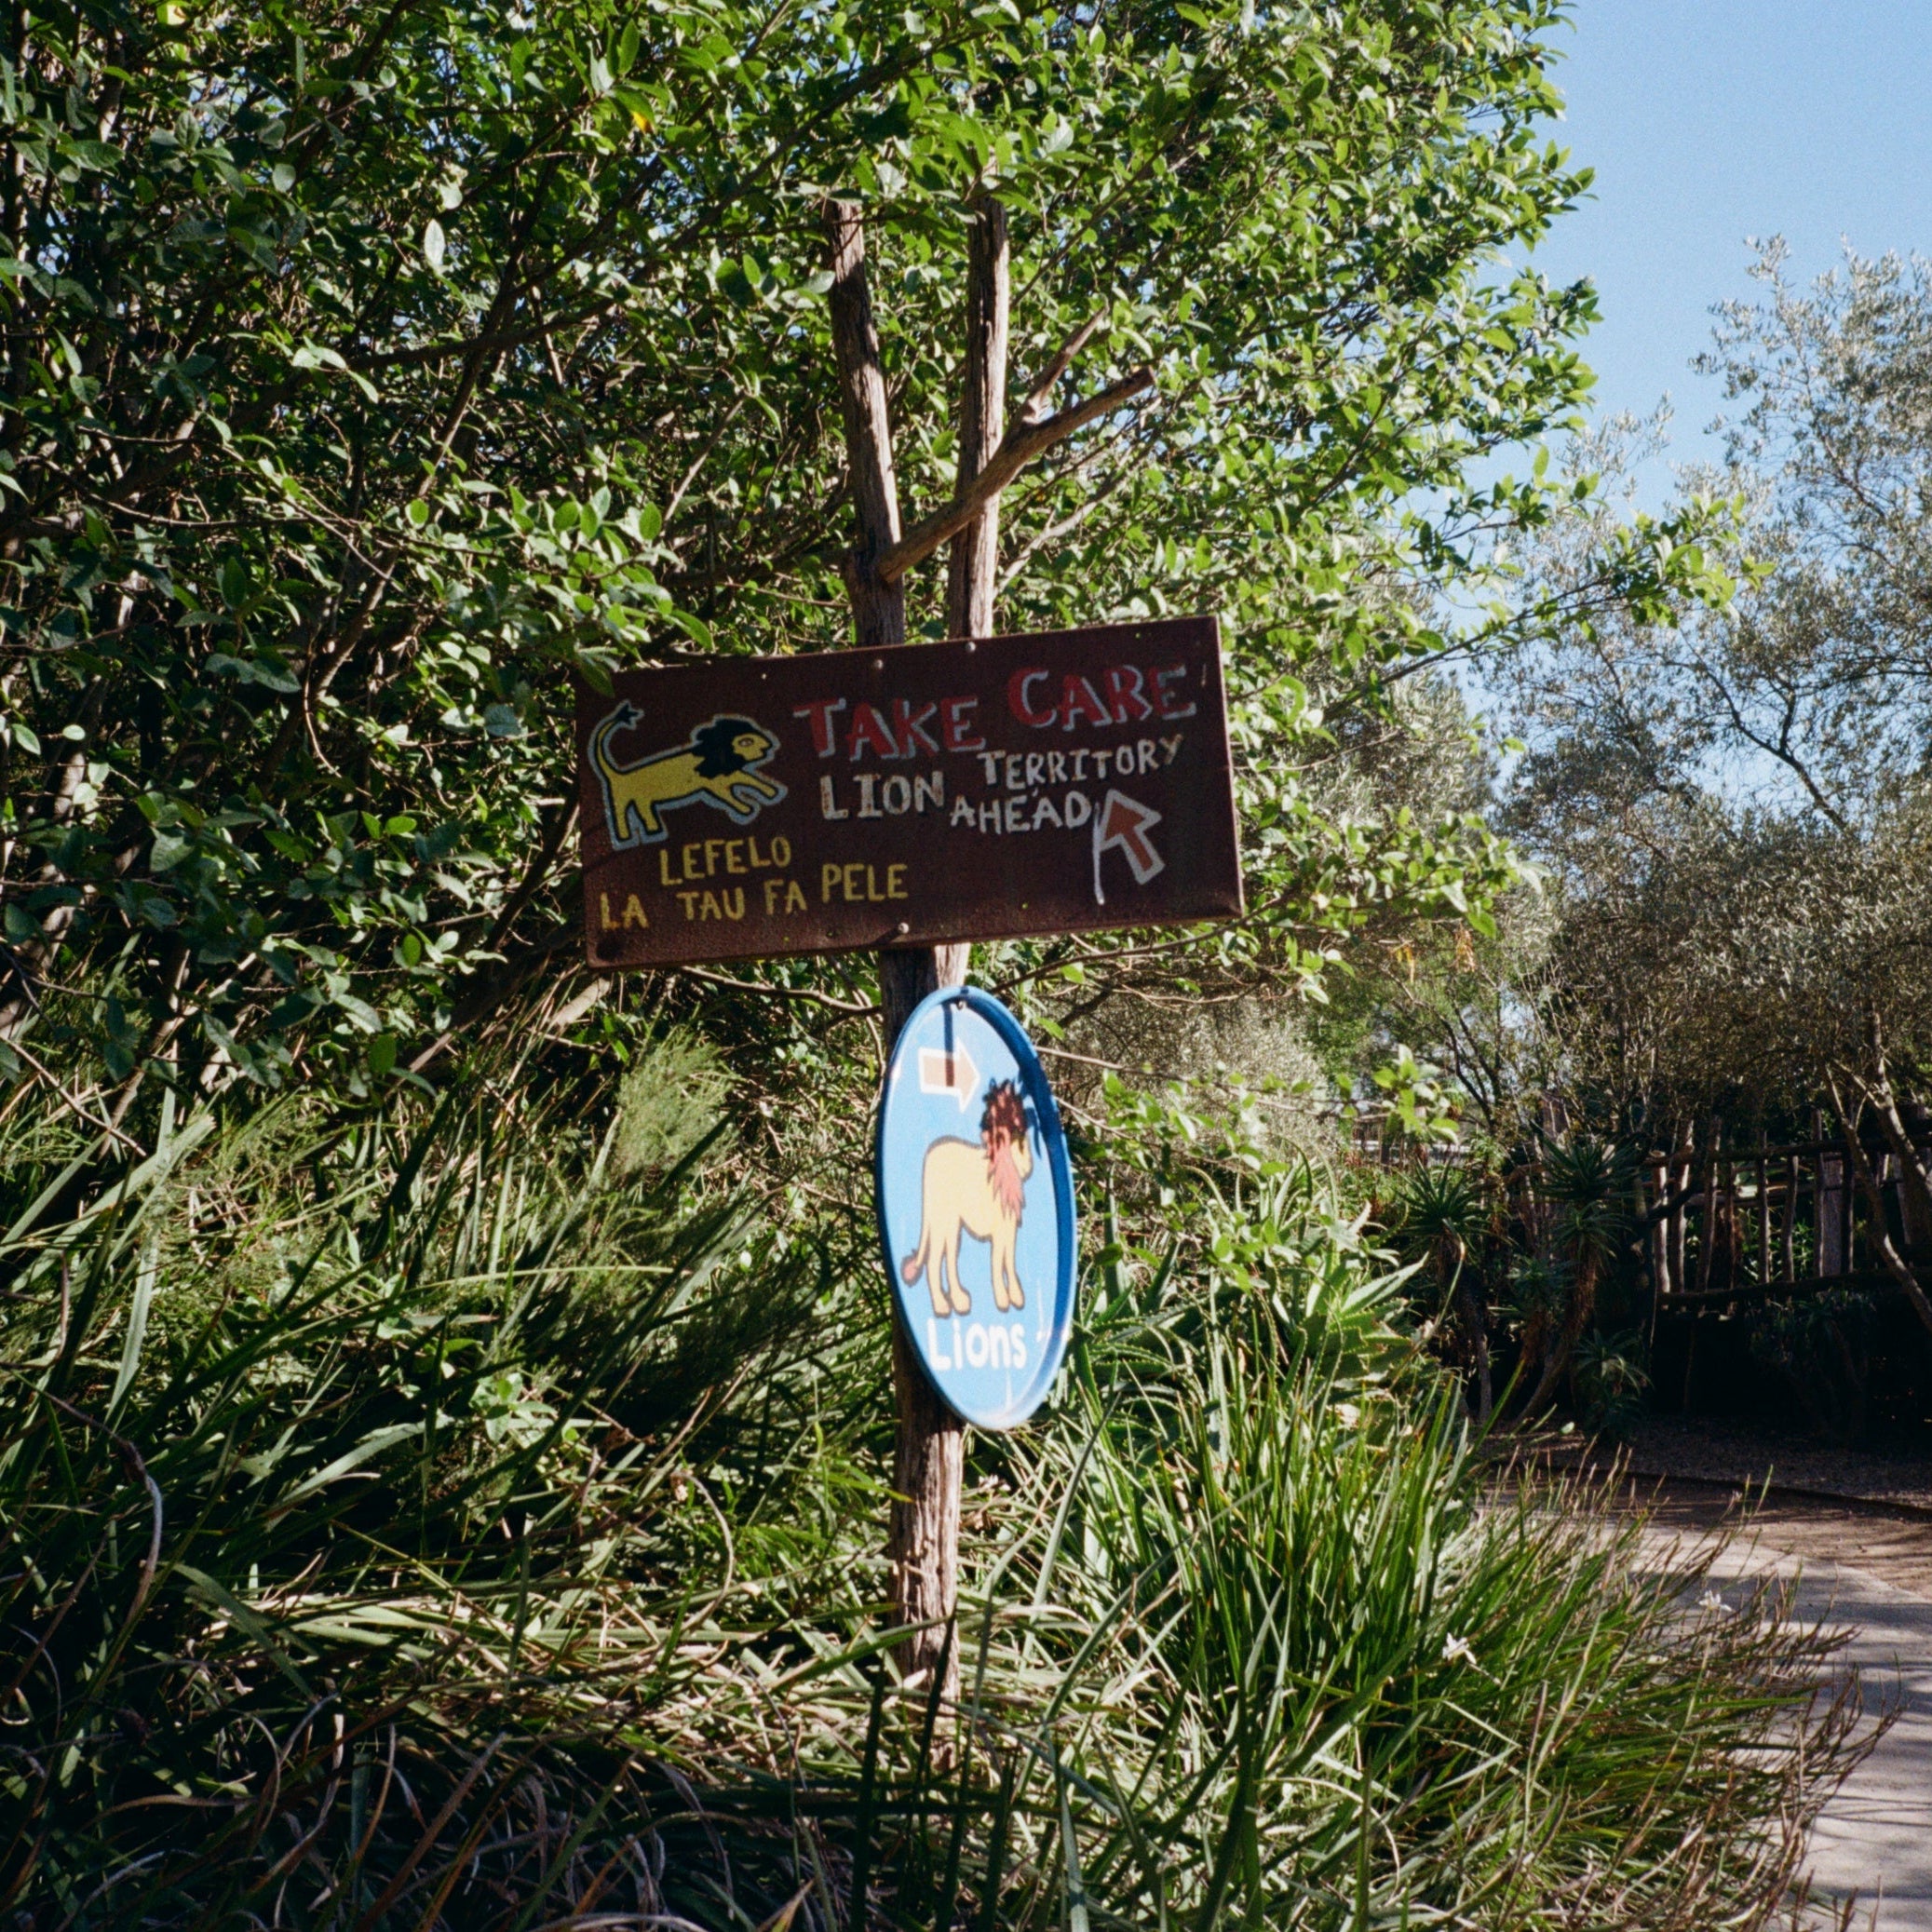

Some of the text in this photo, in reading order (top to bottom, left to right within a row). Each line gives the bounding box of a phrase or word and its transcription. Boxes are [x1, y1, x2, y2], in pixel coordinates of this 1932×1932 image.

[792, 664, 1197, 763] TAKE CARE
[819, 734, 1184, 821] LION TERRITORY
[950, 790, 1092, 835] AHEAD
[659, 835, 791, 886] LEFELO
[600, 863, 909, 930] LA TAU FA PELE
[926, 1317, 1027, 1371] Lions
